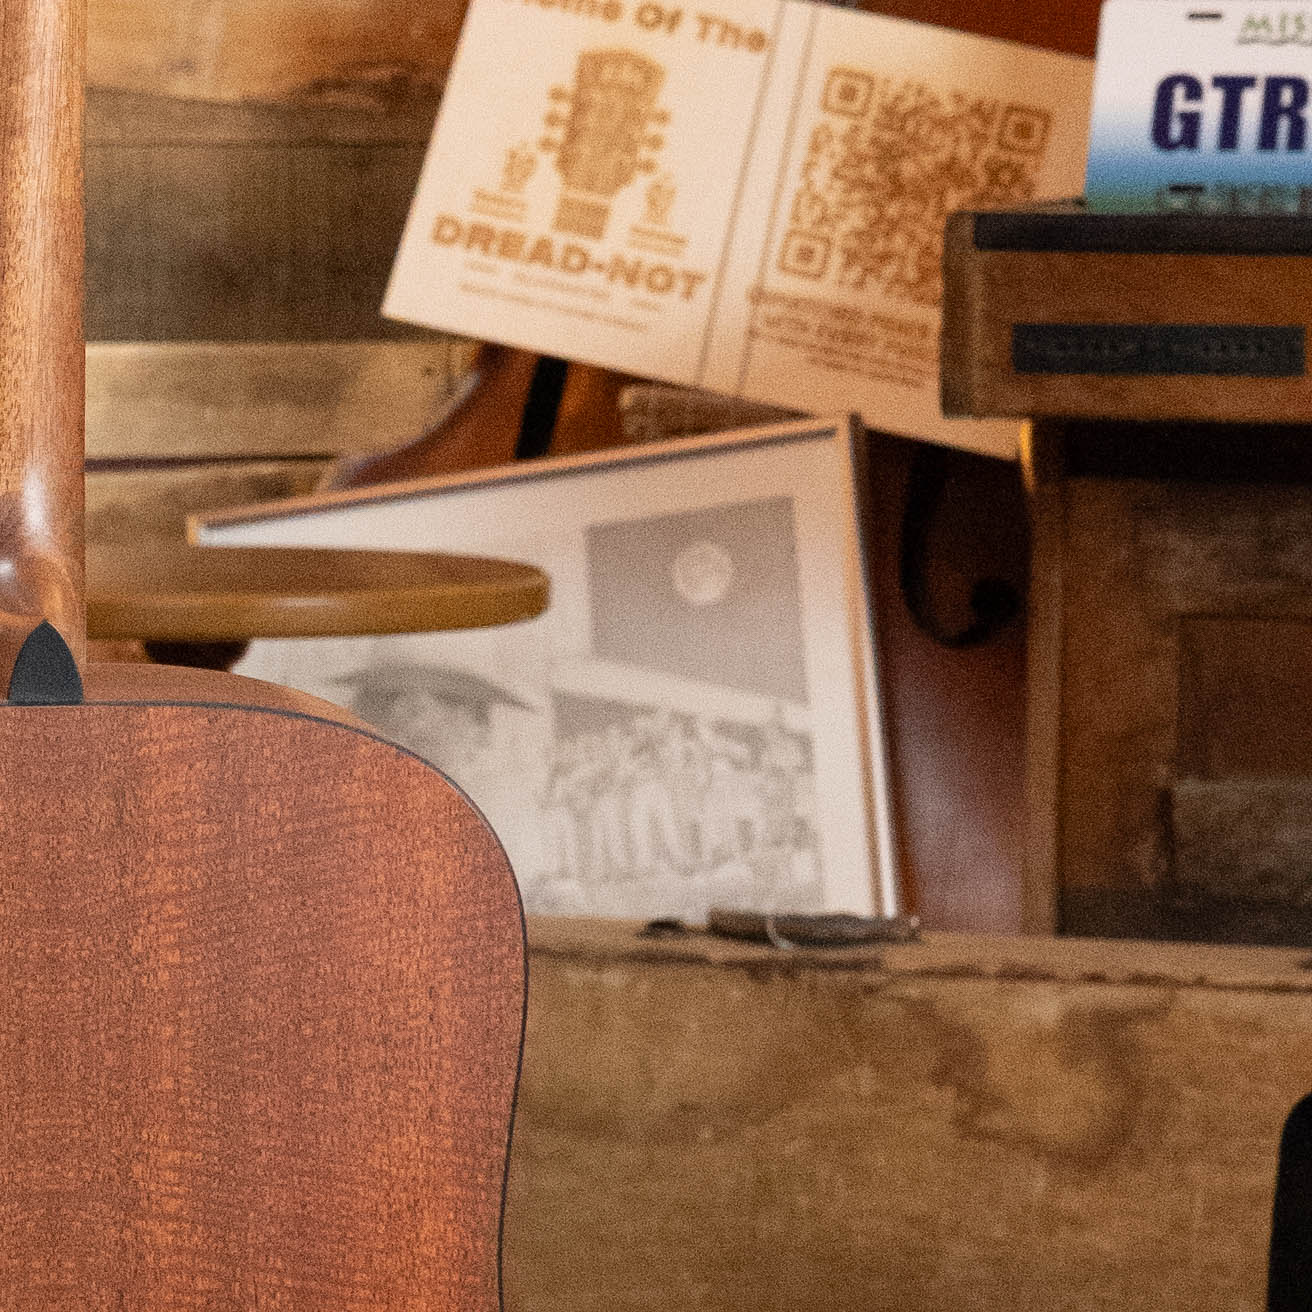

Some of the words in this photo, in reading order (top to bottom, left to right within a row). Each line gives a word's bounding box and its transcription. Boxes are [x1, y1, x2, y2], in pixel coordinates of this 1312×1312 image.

[633, 0, 684, 33] Of
[694, 14, 769, 54] The
[1151, 73, 1310, 153] GTR
[430, 212, 706, 301] DREAD-NOT
